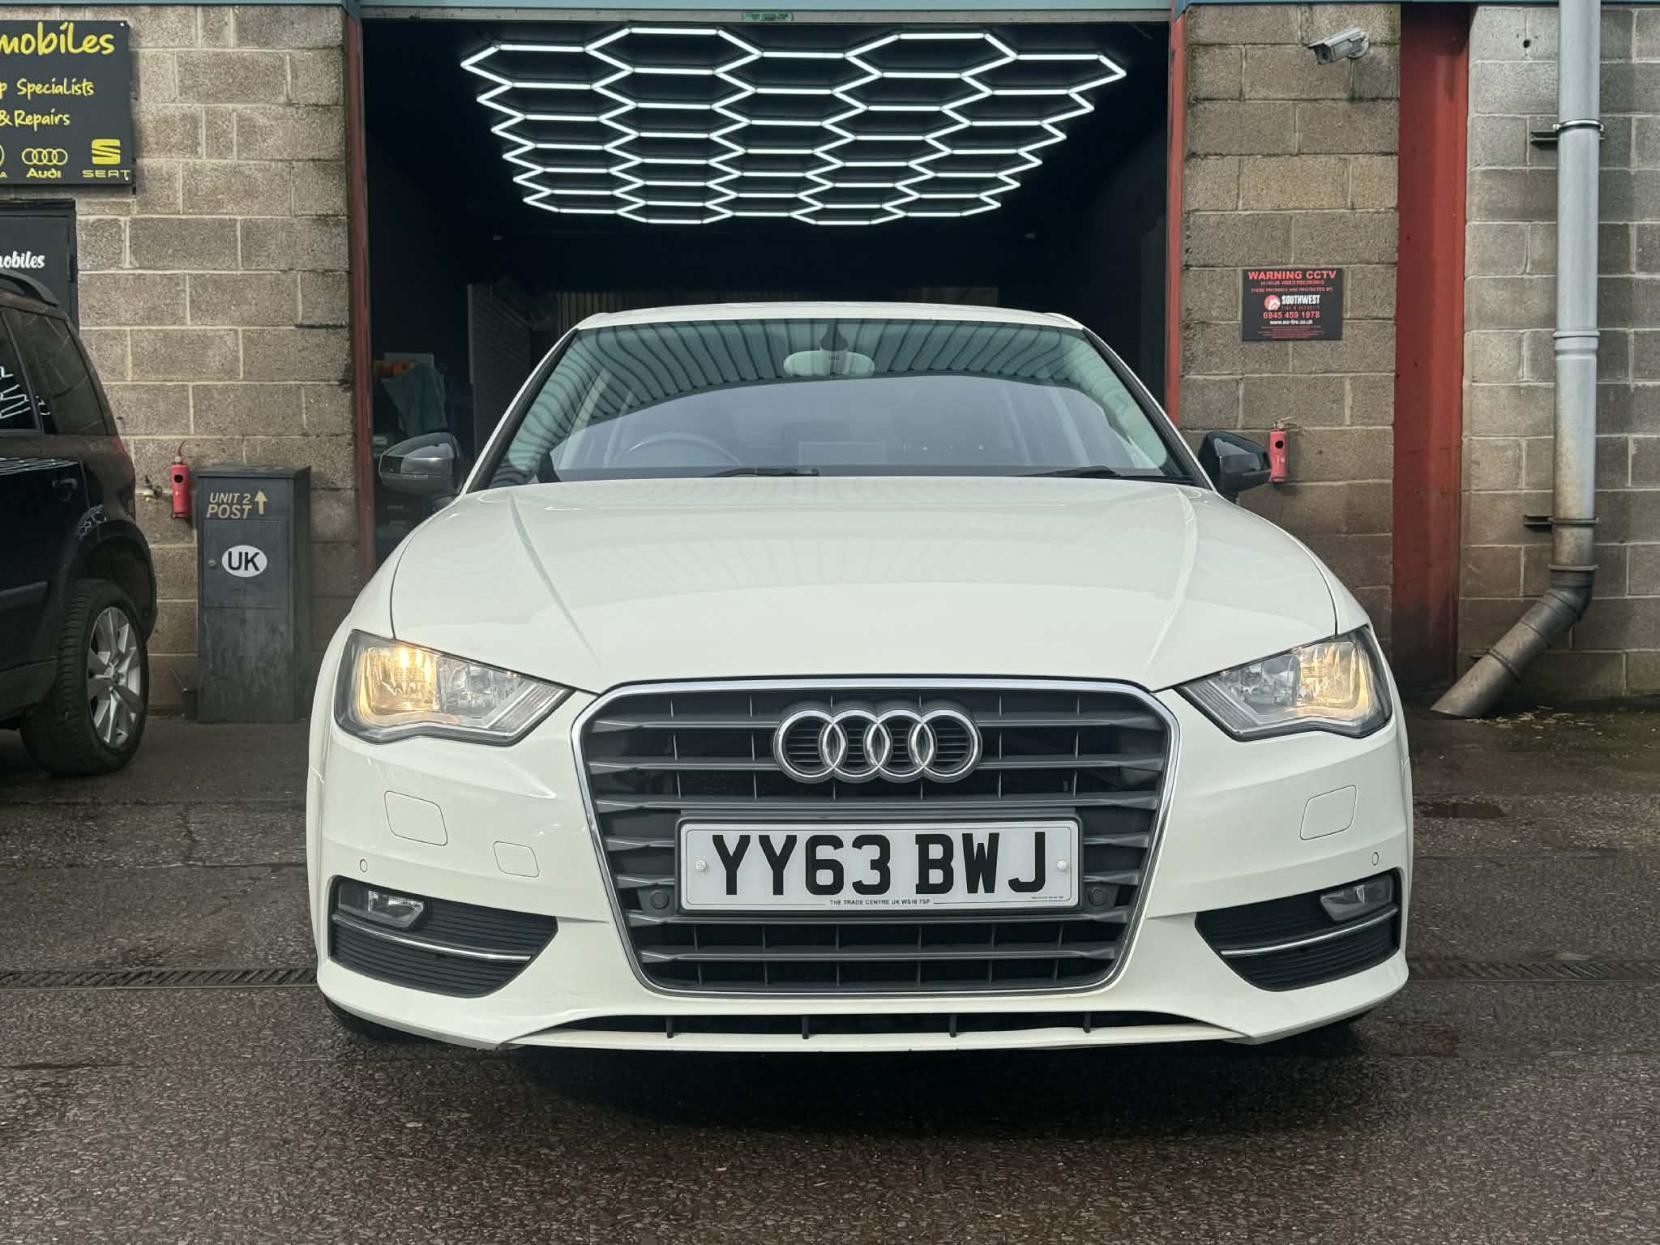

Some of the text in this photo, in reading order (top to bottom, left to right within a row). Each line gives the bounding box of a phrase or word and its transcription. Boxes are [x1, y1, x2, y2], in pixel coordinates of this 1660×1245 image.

[16, 78, 95, 100] Specialists
[14, 108, 71, 132] Repairs
[26, 168, 62, 178] Audi
[82, 170, 131, 180] SEAT
[1248, 271, 1337, 280] WARNING CCTV
[1281, 295, 1320, 305] SOUTHWEST
[209, 492, 251, 504] UNIT 2
[206, 504, 252, 519] POST
[228, 551, 260, 571] UK
[711, 831, 1046, 896] YY63 BWJ
